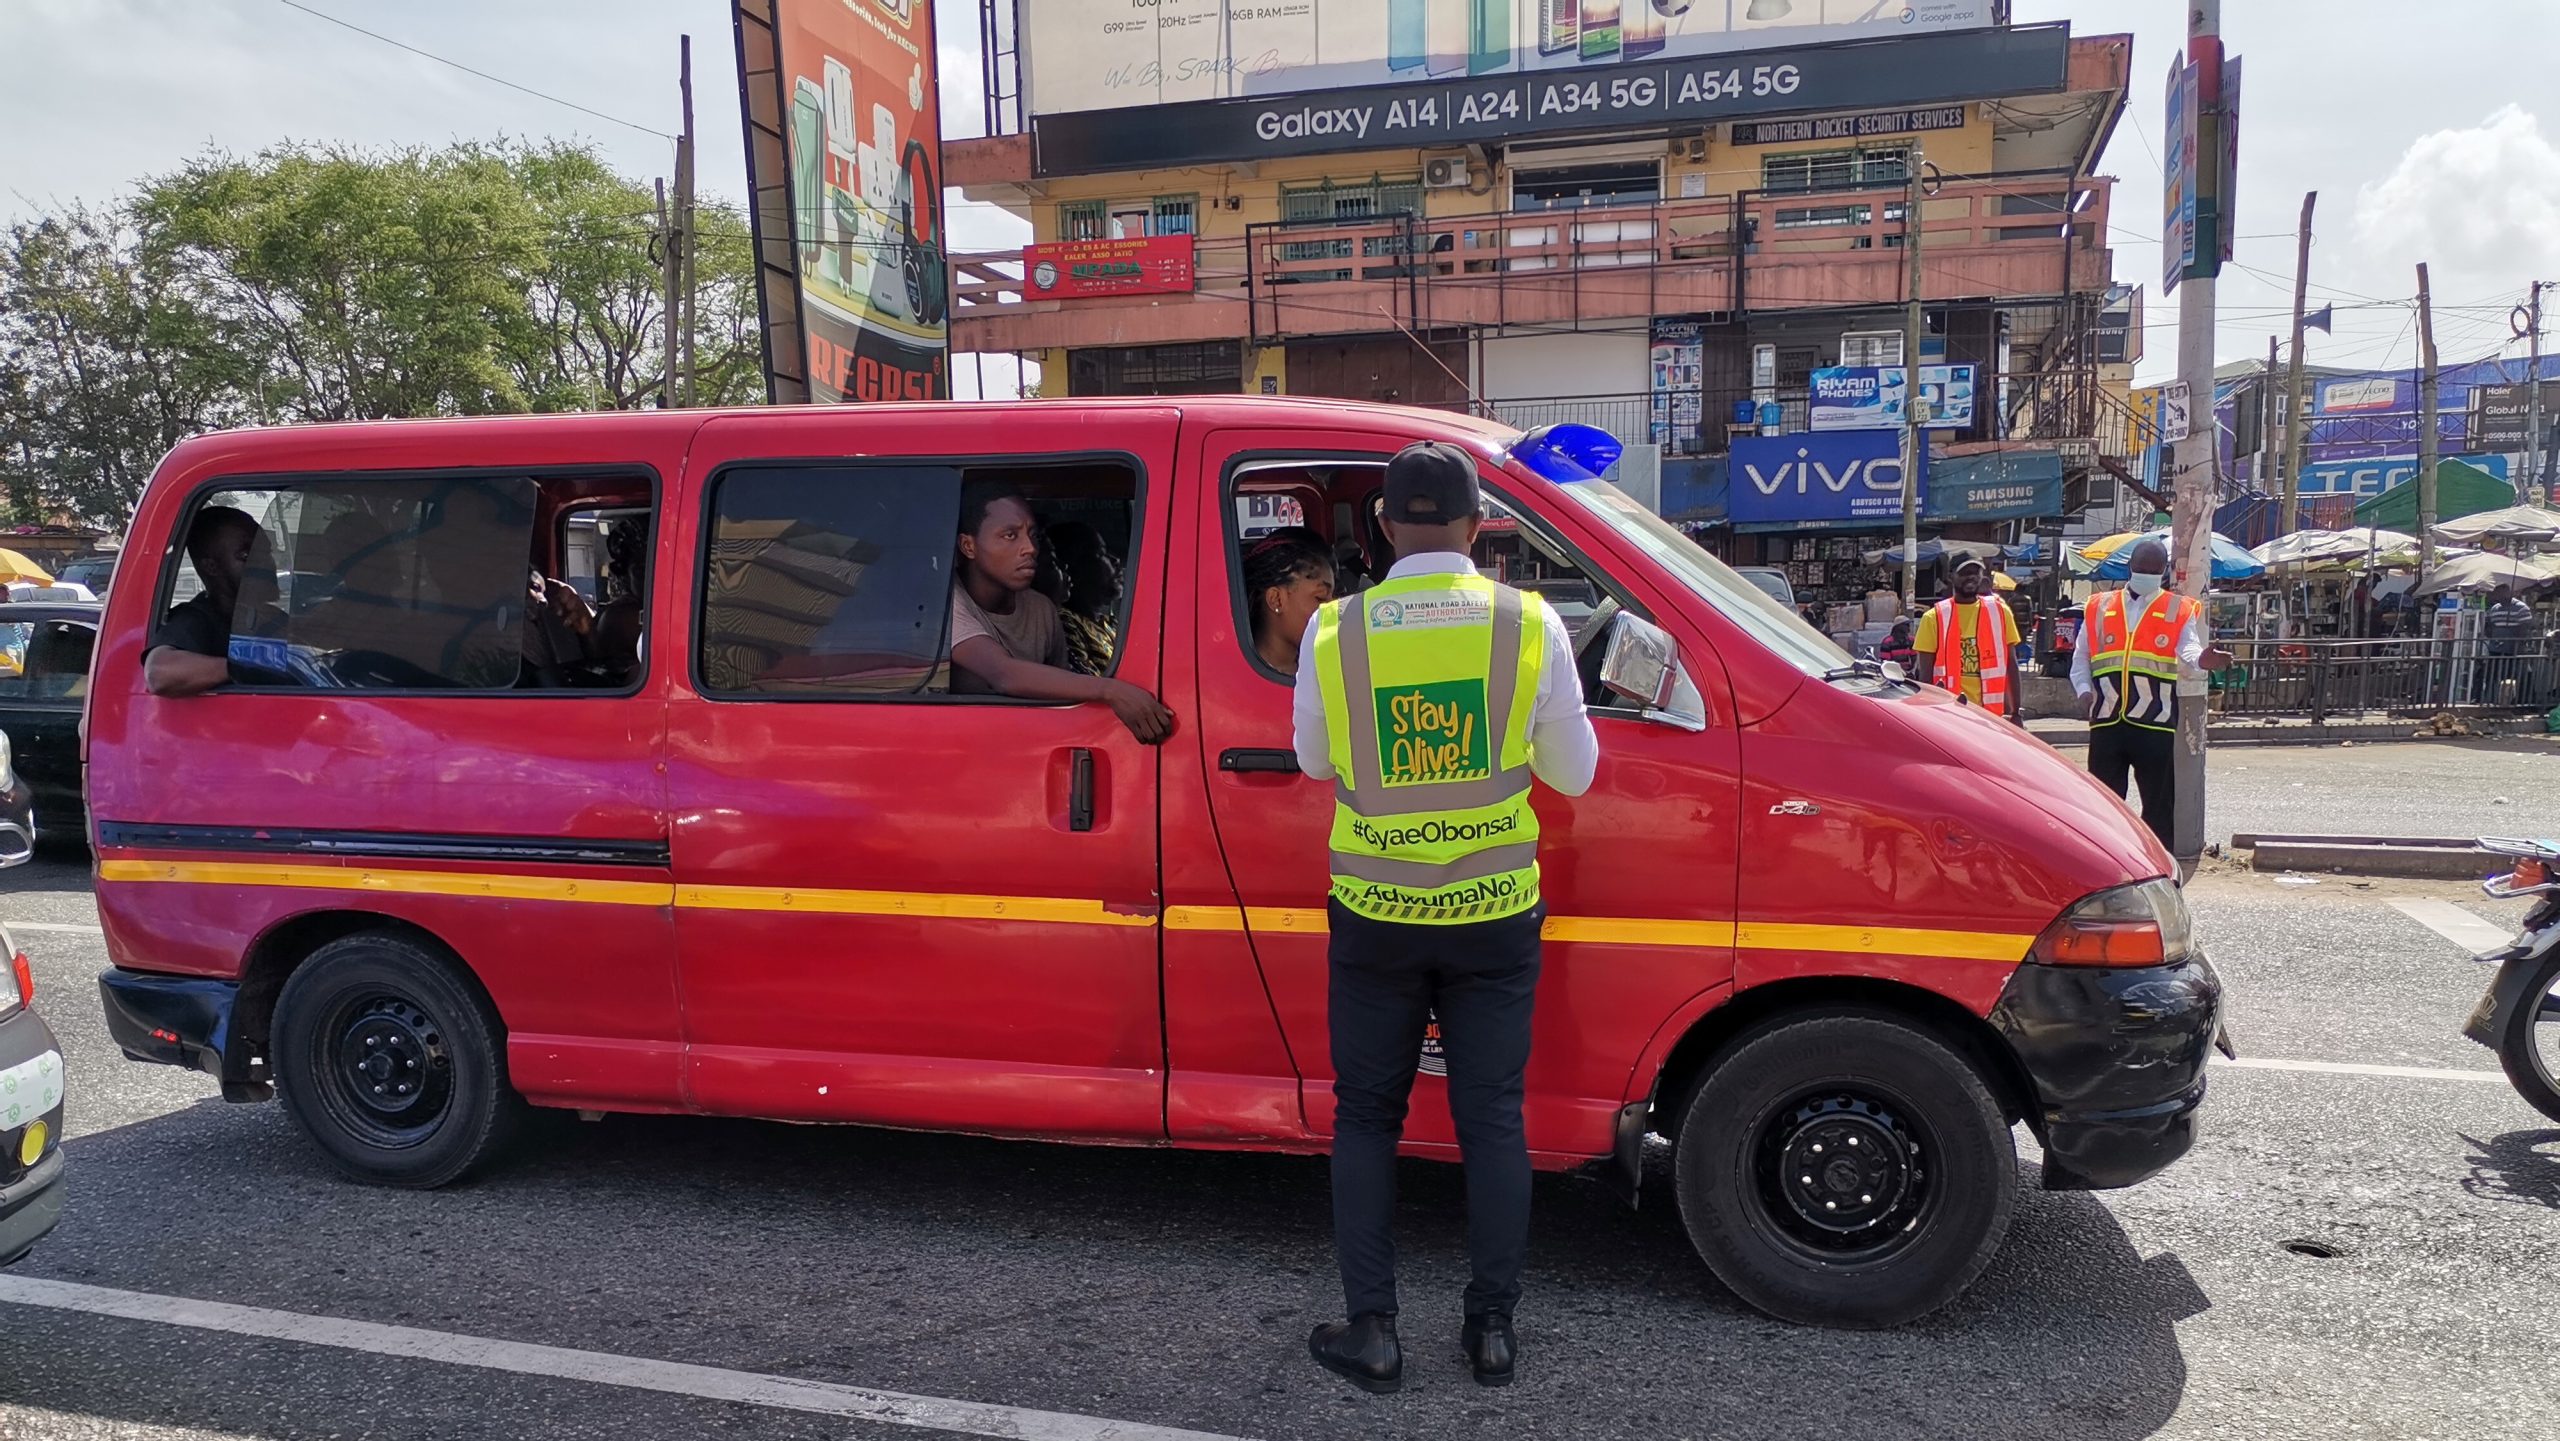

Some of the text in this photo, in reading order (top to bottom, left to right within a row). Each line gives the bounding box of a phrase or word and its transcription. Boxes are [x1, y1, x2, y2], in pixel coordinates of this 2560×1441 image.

[1228, 9, 1254, 21] 16GB
[1256, 7, 1282, 19] RAM
[1921, 10, 1975, 23] Google apps
[1103, 22, 1125, 34] G99
[1157, 15, 1187, 29] 120Hz
[1255, 64, 1801, 142] Galaxy A14 A24 A34 5G A54 5G
[1756, 119, 1812, 143] NORTHERN
[1815, 117, 1855, 139] ROCKET
[1858, 112, 1910, 135] SECURITY
[1911, 107, 1963, 129] SERVICES
[1100, 240, 1148, 250] ACESSORIES
[1092, 250, 1134, 259] ASSOIATIO
[1816, 377, 1876, 391] RIYAM
[1818, 388, 1874, 399] PHONES
[2486, 387, 2512, 396] Haier
[2485, 404, 2517, 415] Global
[1744, 447, 1904, 496] vivo
[1967, 485, 2034, 502] SAMSUNG
[1968, 498, 2034, 511] smartphones
[1405, 599, 1488, 610] NATIONAL ROAD SAFETY
[1425, 607, 1468, 618] AUTHORITY
[1390, 689, 1460, 738] Stay
[1391, 712, 1474, 776] Alive!
